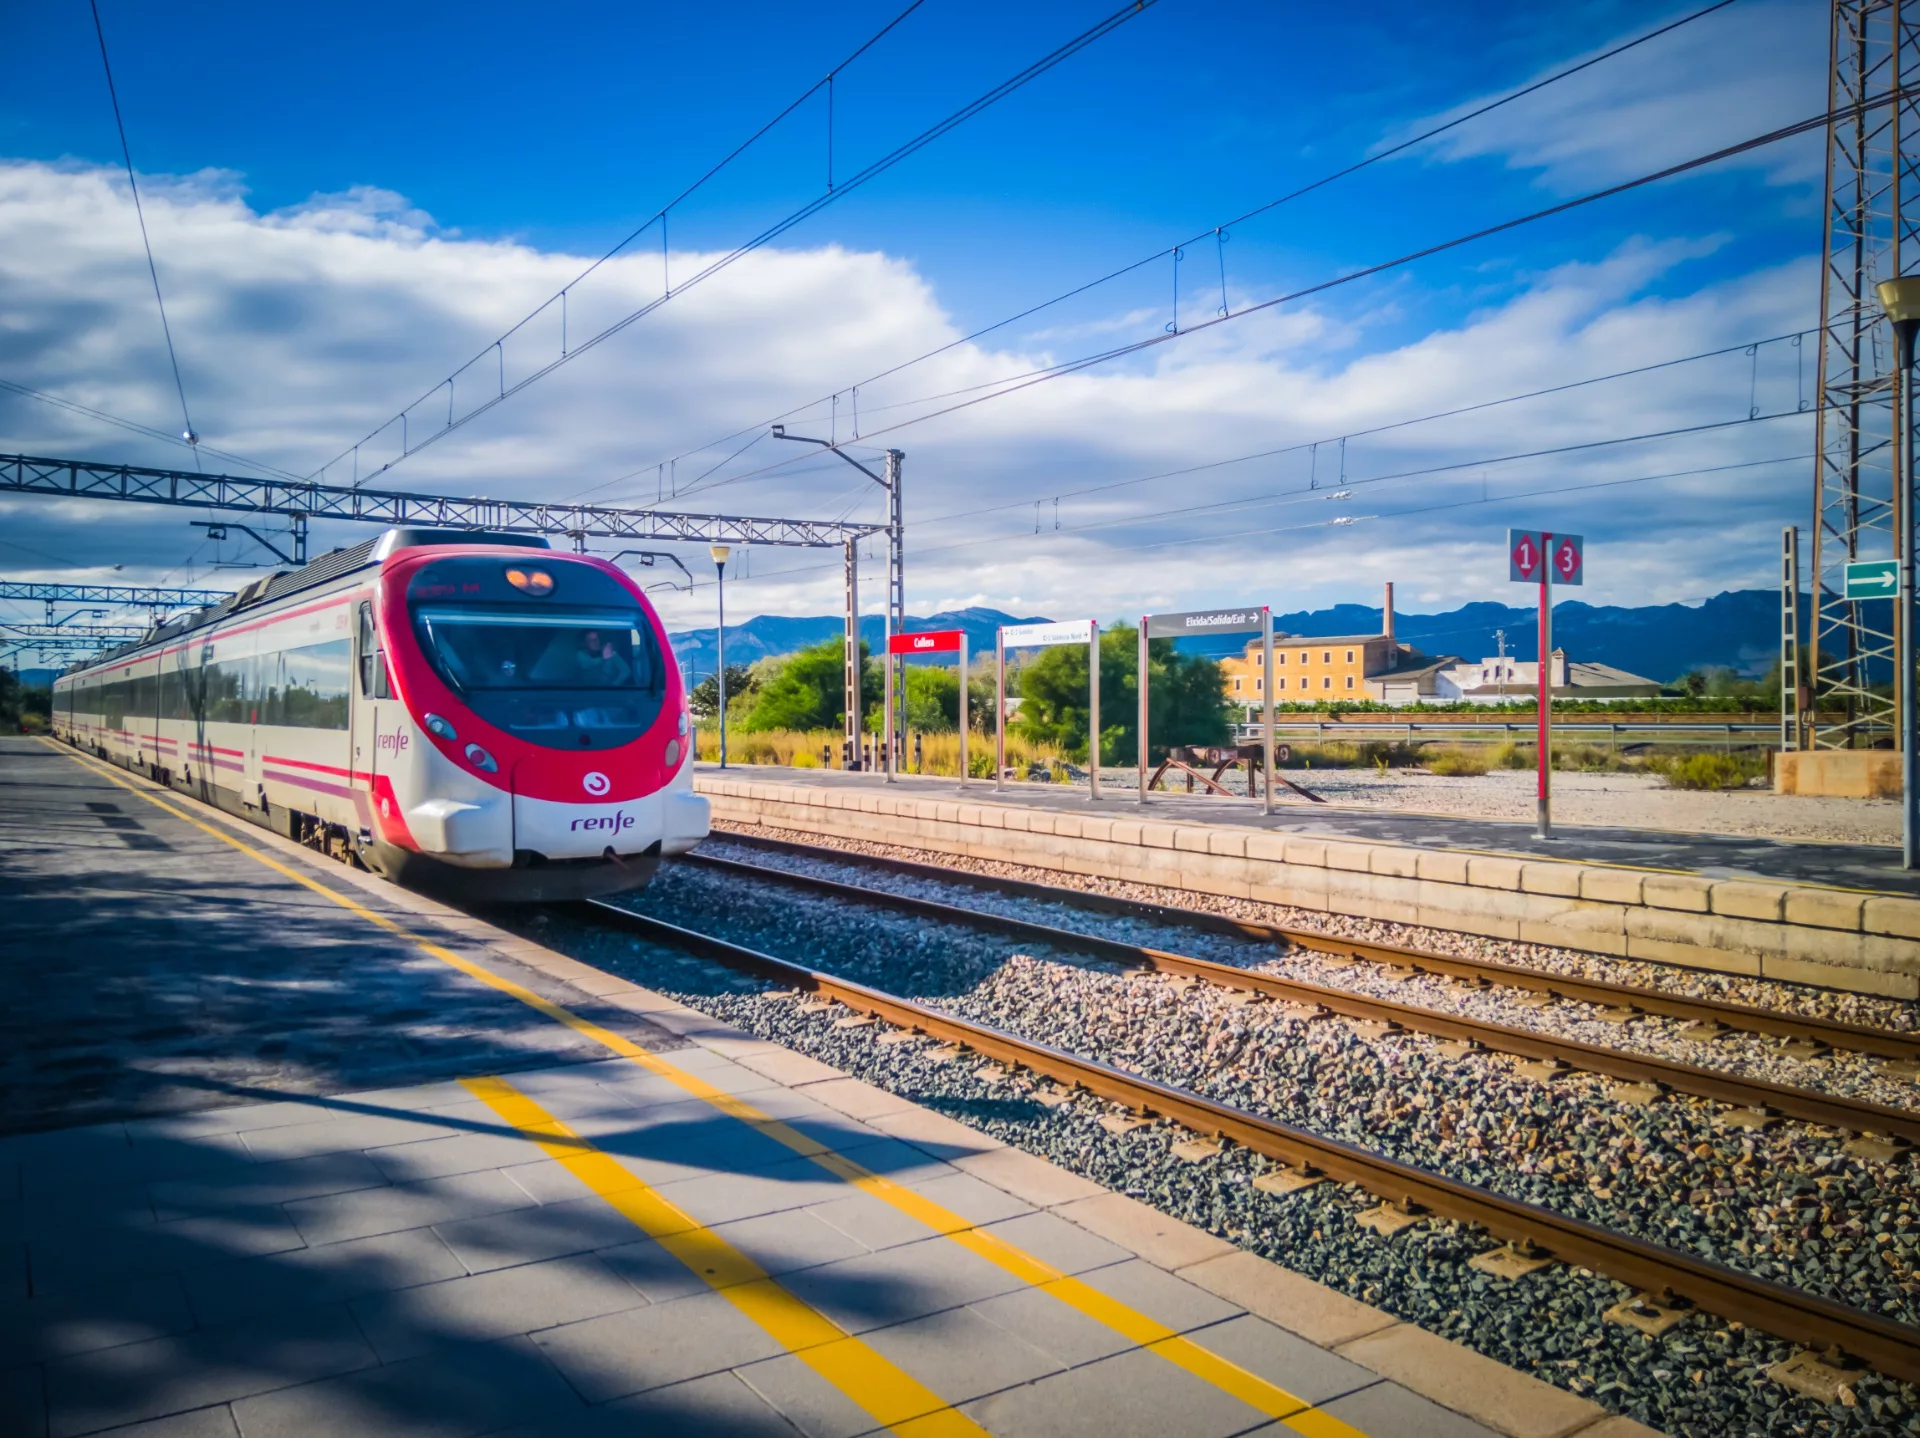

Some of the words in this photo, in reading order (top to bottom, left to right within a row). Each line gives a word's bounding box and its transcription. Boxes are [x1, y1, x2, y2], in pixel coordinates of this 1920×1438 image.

[1520, 543, 1531, 569] 1
[1562, 546, 1573, 572] 3
[913, 636, 935, 649] Cullera
[377, 725, 409, 759] renfe
[570, 809, 636, 837] renfe
